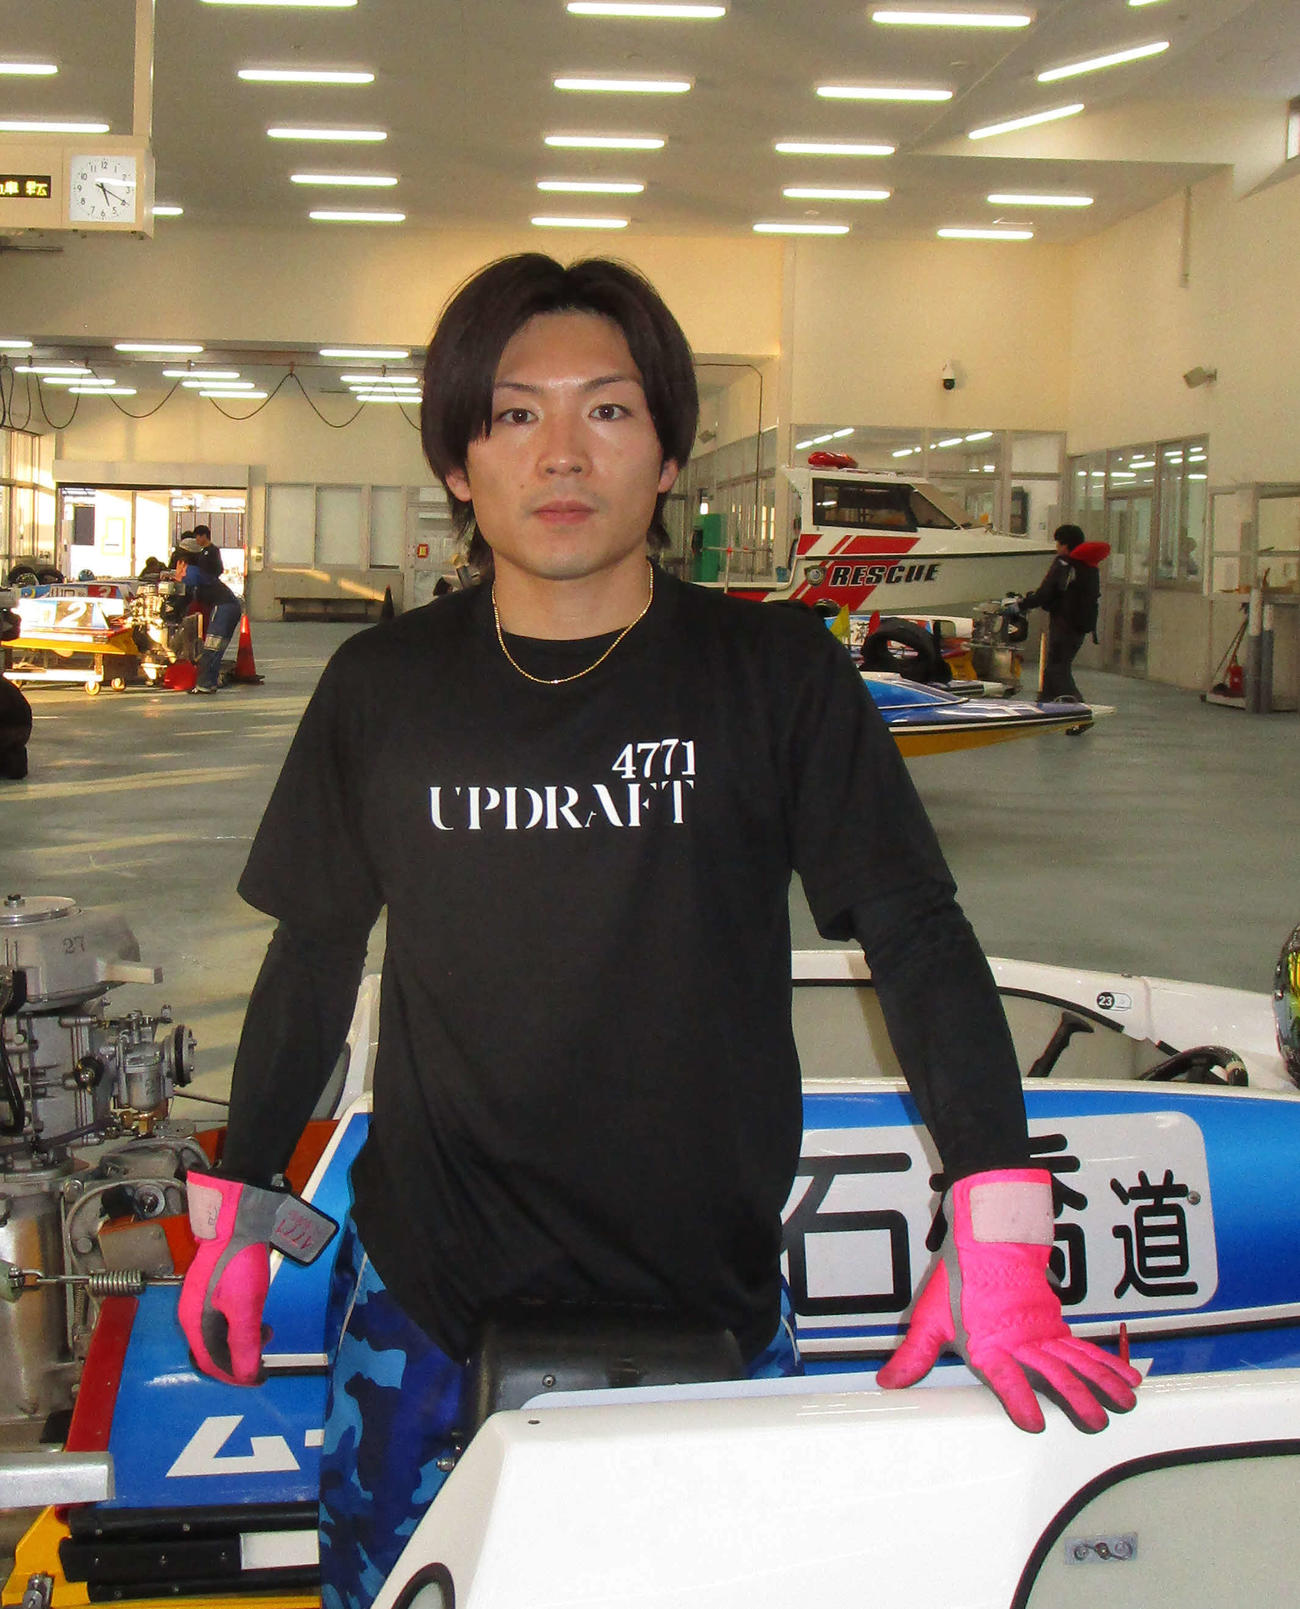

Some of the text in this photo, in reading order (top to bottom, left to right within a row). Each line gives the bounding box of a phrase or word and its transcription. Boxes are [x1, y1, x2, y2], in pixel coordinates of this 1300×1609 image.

[91, 165, 97, 173] 11
[101, 161, 108, 169] 12
[81, 173, 88, 181] 10
[829, 563, 940, 587] RESCUE
[58, 602, 88, 627] 2
[611, 738, 696, 779] 4771
[428, 780, 695, 830] UPDRAFT
[62, 935, 85, 954] 27
[1098, 994, 1112, 1006] 23
